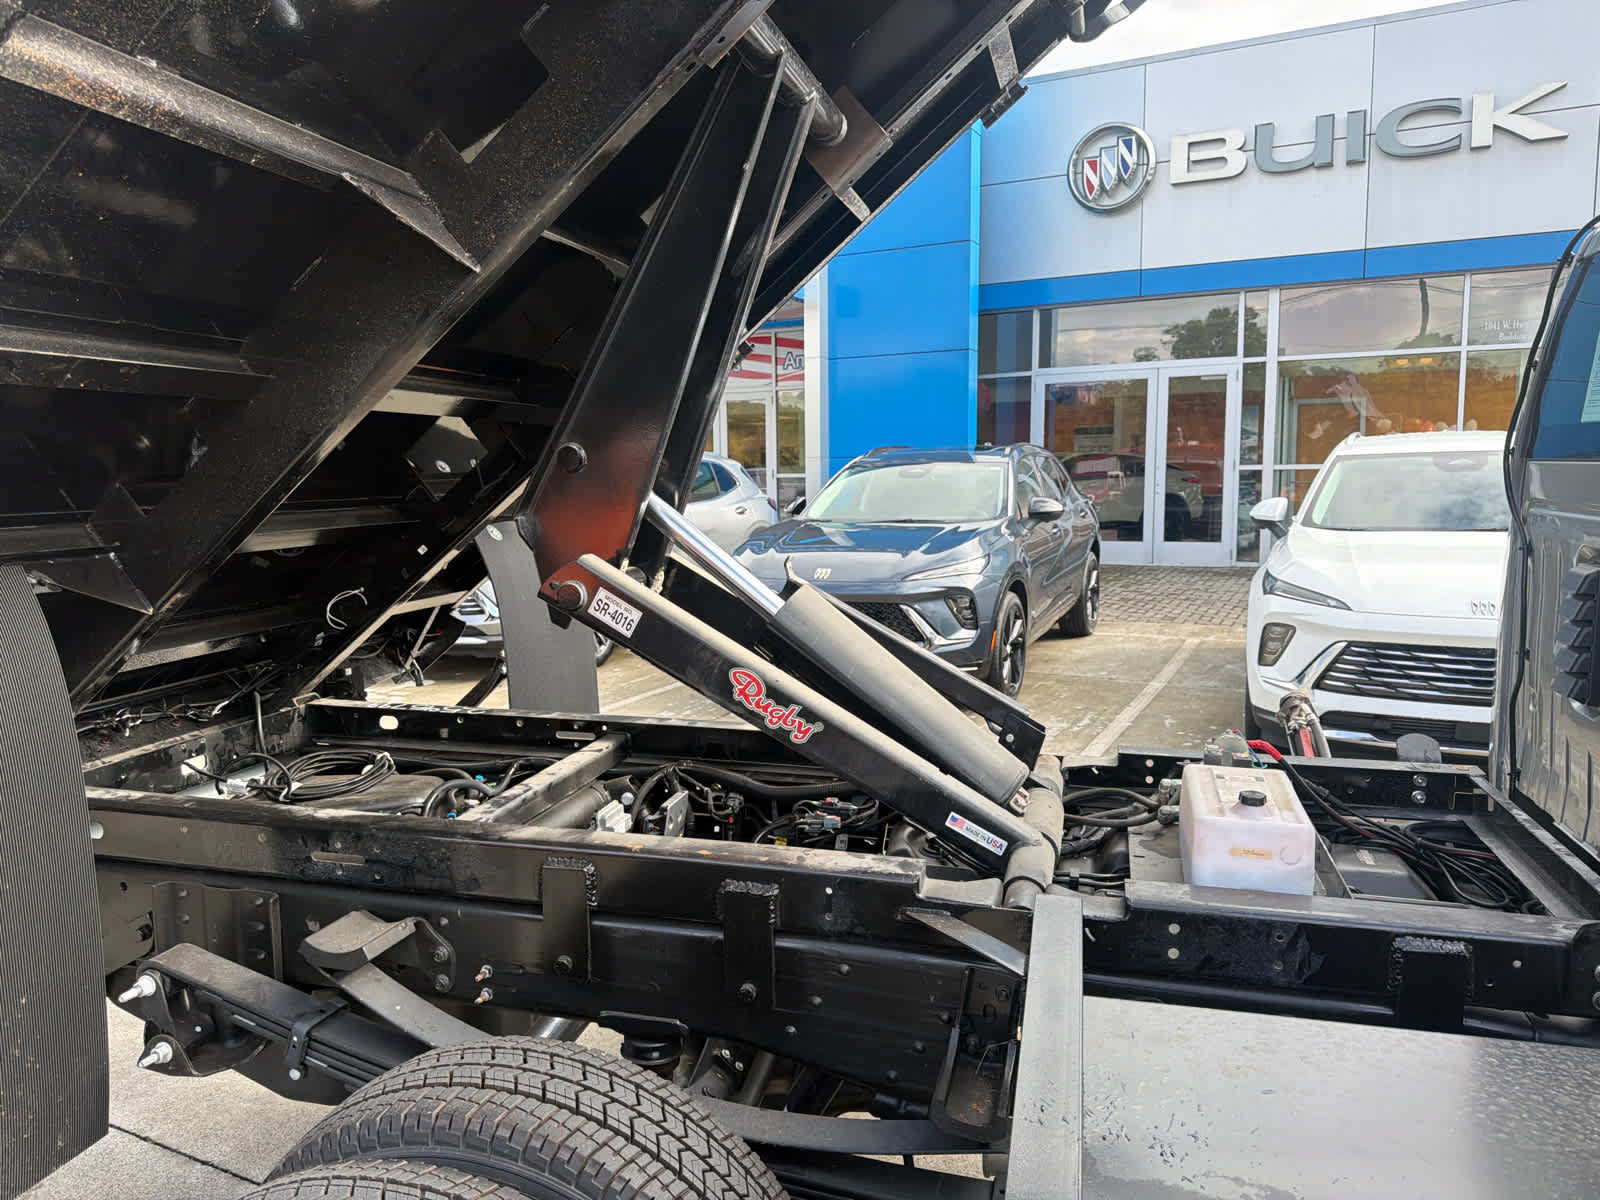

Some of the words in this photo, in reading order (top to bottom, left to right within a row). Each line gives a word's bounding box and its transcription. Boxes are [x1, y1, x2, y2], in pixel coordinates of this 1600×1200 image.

[1170, 80, 1569, 186] BUICK
[594, 598, 635, 632] SR-4016
[729, 668, 814, 743] Rugby
[986, 837, 1004, 851] USA
